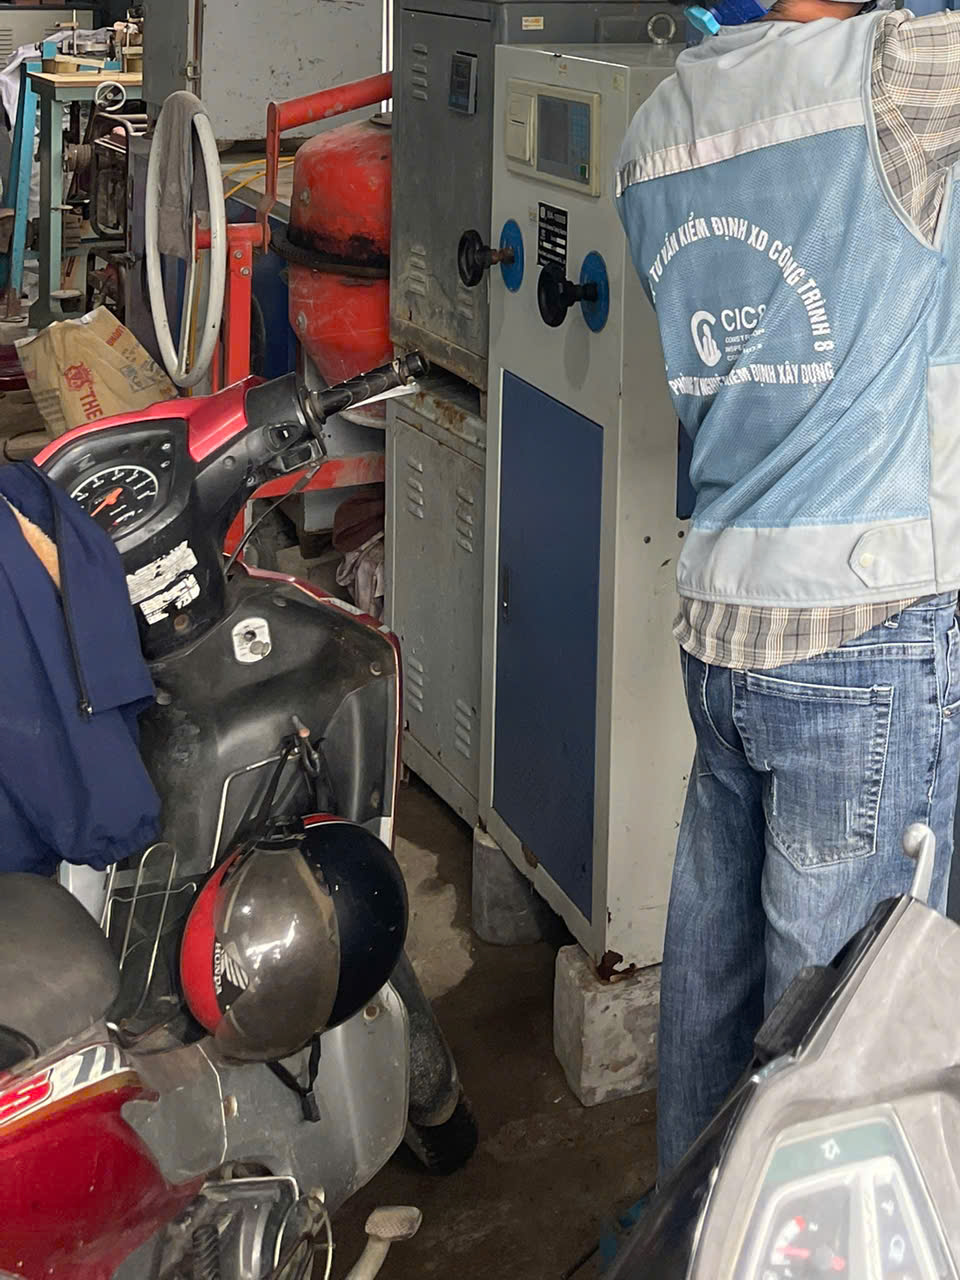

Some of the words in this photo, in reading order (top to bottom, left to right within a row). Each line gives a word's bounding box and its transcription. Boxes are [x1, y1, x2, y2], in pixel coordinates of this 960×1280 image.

[711, 216, 747, 241] ĐỊNH
[747, 224, 769, 252] XD
[649, 253, 663, 282] TƯ
[768, 240, 806, 287] CÔNG
[796, 278, 831, 336] TRÌNH
[813, 340, 834, 352] 8
[777, 361, 800, 384] XÂY
[801, 361, 834, 387] DỰNG
[214, 942, 222, 996] HONDA
